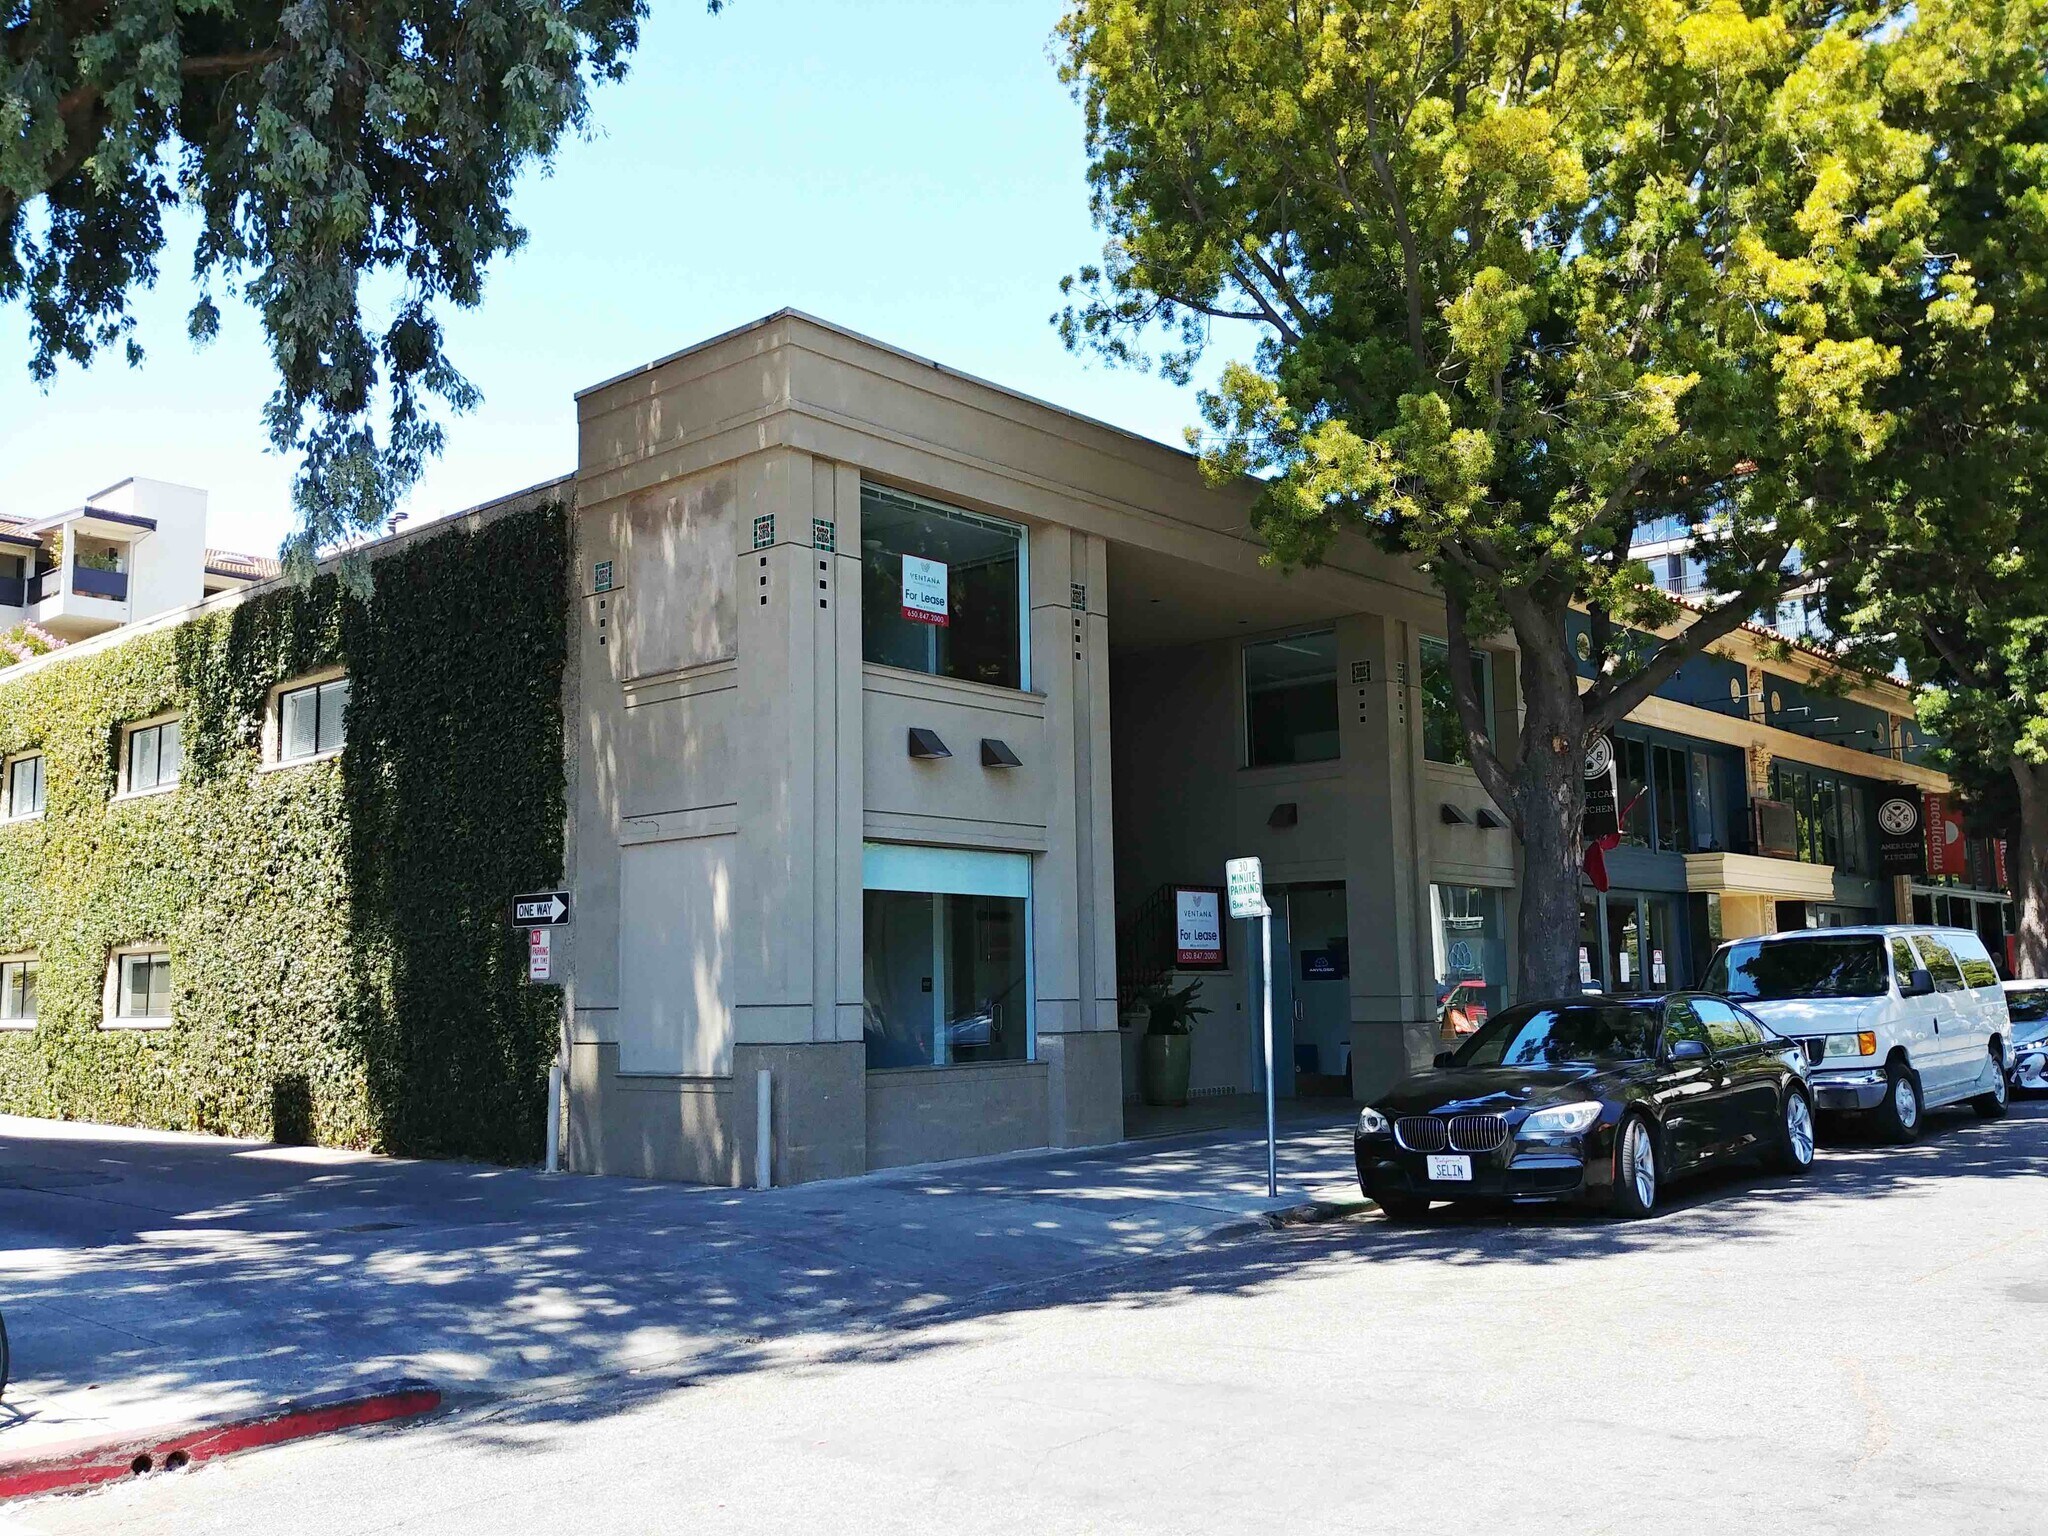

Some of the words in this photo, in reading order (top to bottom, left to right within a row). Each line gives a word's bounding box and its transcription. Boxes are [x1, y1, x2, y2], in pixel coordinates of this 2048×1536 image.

[910, 573, 940, 584] VENTANA
[905, 589, 917, 601] For
[921, 592, 945, 606] Lease
[1881, 842, 1920, 850] AMERICAN
[1239, 861, 1248, 872] 30
[1231, 871, 1256, 884] MINUTE
[1230, 882, 1261, 895] PARKING
[518, 904, 534, 917] ONE
[536, 903, 553, 916] WAY
[1184, 910, 1212, 918] VENTANA
[1180, 929, 1191, 940] For
[1194, 929, 1217, 941] Lease
[532, 946, 549, 955] PARKING
[1182, 952, 1217, 960] 650.847.2000
[1436, 1164, 1463, 1176] SELIN
